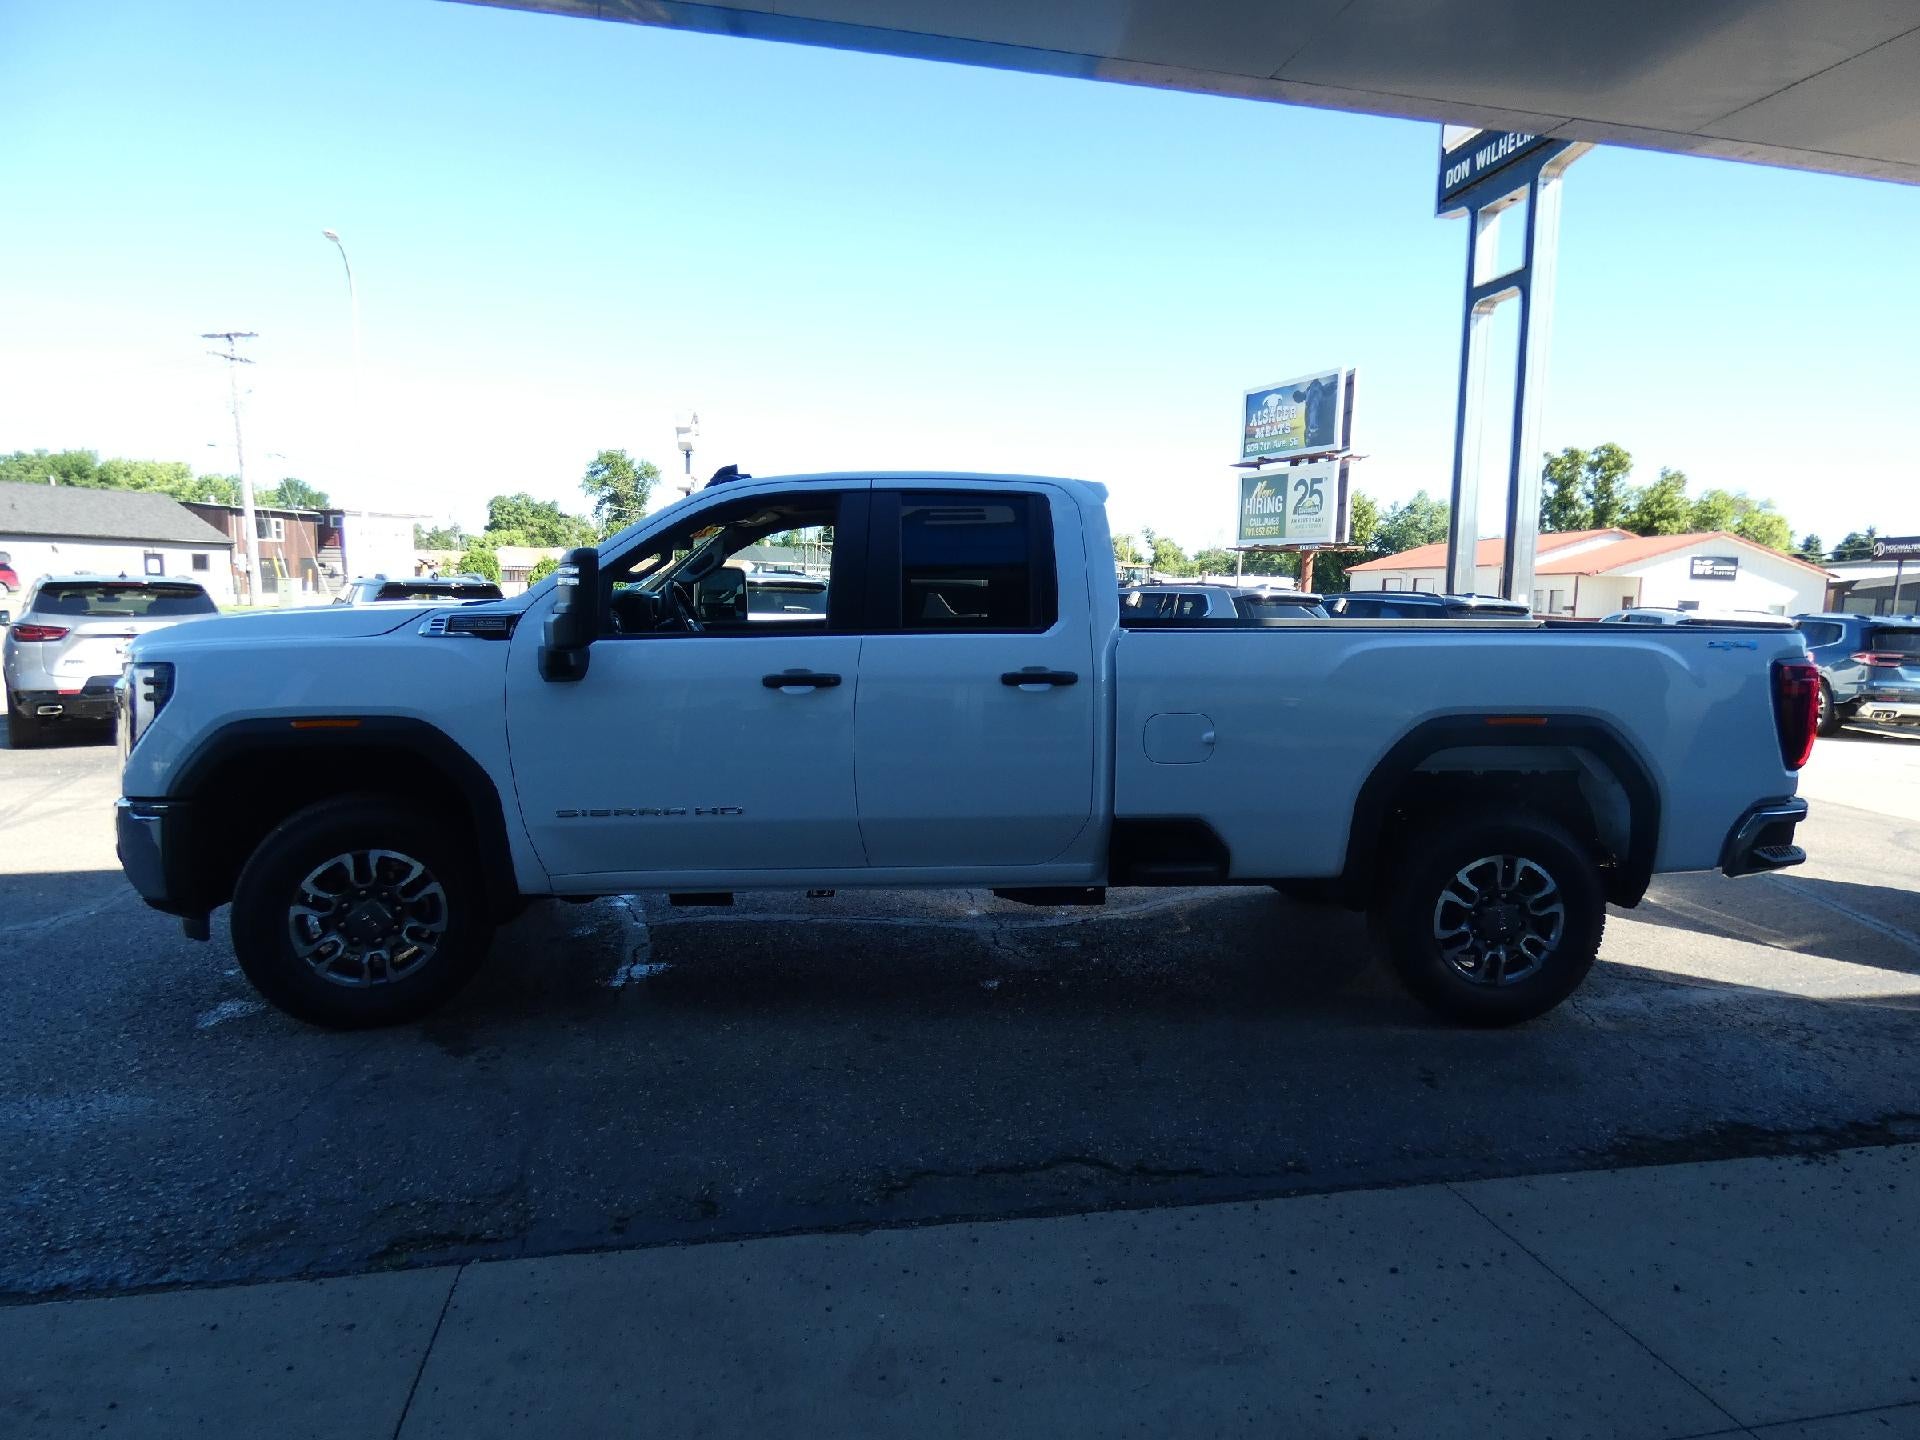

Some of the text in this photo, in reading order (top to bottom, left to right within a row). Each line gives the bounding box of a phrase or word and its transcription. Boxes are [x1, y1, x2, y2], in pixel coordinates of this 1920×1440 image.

[1445, 158, 1471, 189] DON
[1254, 423, 1291, 439] MEATS
[1245, 495, 1283, 515] HIRING
[1293, 477, 1324, 515] 25
[556, 806, 743, 817] SIERRA HD
